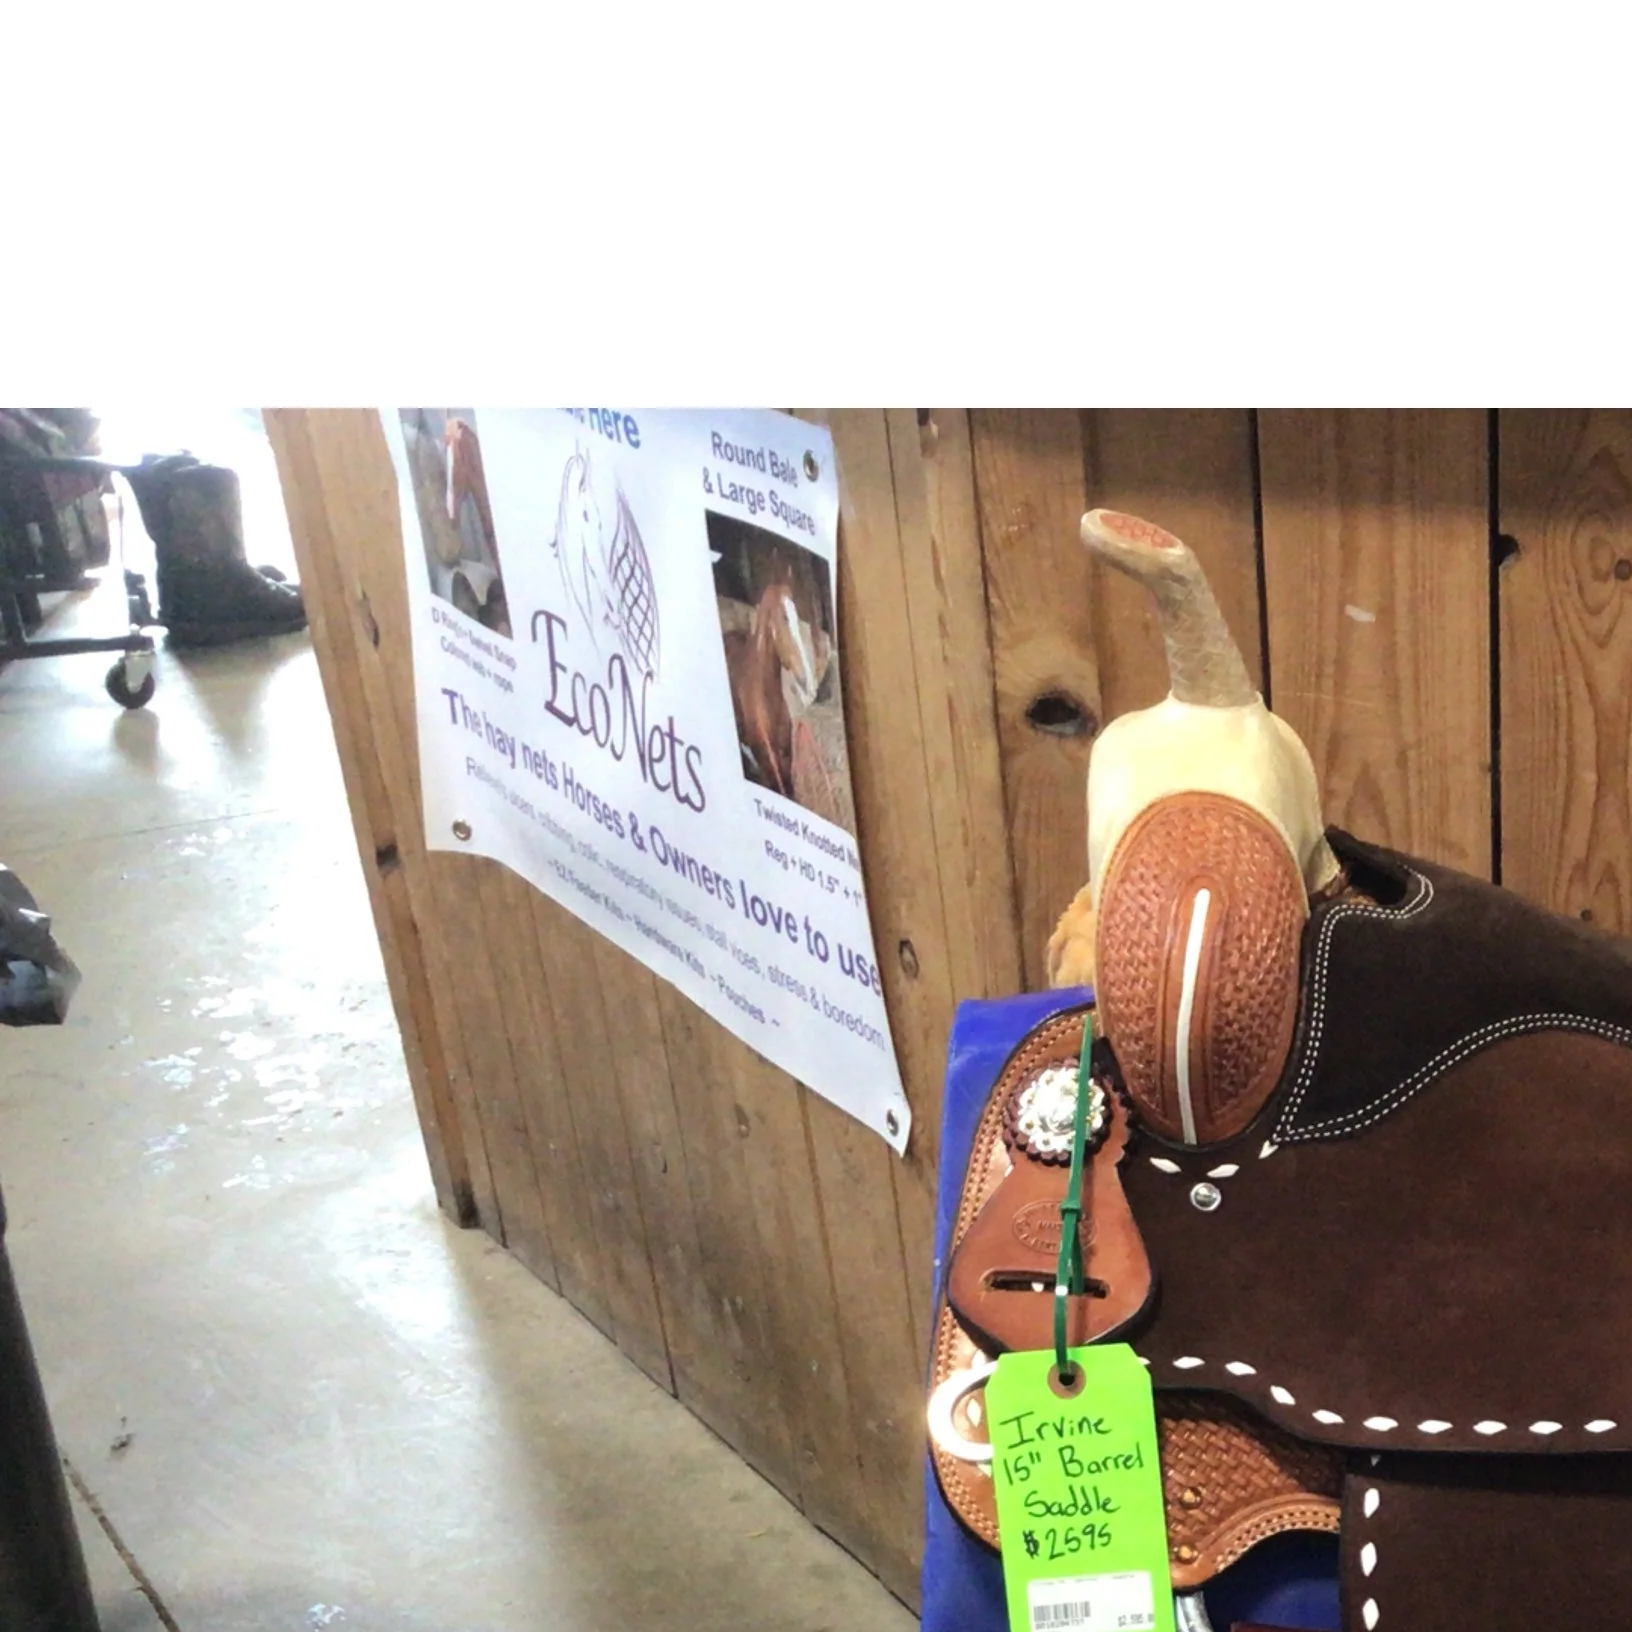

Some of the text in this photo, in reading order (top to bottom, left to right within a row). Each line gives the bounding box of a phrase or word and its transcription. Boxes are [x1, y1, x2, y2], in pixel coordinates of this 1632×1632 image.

[711, 430, 798, 489] Round Bale
[702, 465, 816, 536] & Large Square
[530, 609, 706, 814] EcoNets
[440, 687, 483, 739] The
[481, 711, 517, 770] hay
[520, 741, 559, 791] nets
[561, 761, 626, 840] Horses
[627, 810, 648, 854] &
[649, 825, 736, 911] Owners
[739, 878, 799, 945] love
[803, 914, 830, 964] to
[836, 942, 882, 998] use
[753, 797, 800, 837] Twisted
[801, 821, 846, 862] Knotted
[764, 839, 789, 872] Reg
[798, 855, 816, 882] HD
[767, 964, 809, 1003] stress
[809, 986, 821, 1012] &
[998, 1411, 1113, 1449] Irvine
[1003, 1441, 1145, 1486] 15" Barrel
[1023, 1484, 1122, 1518] Saddle
